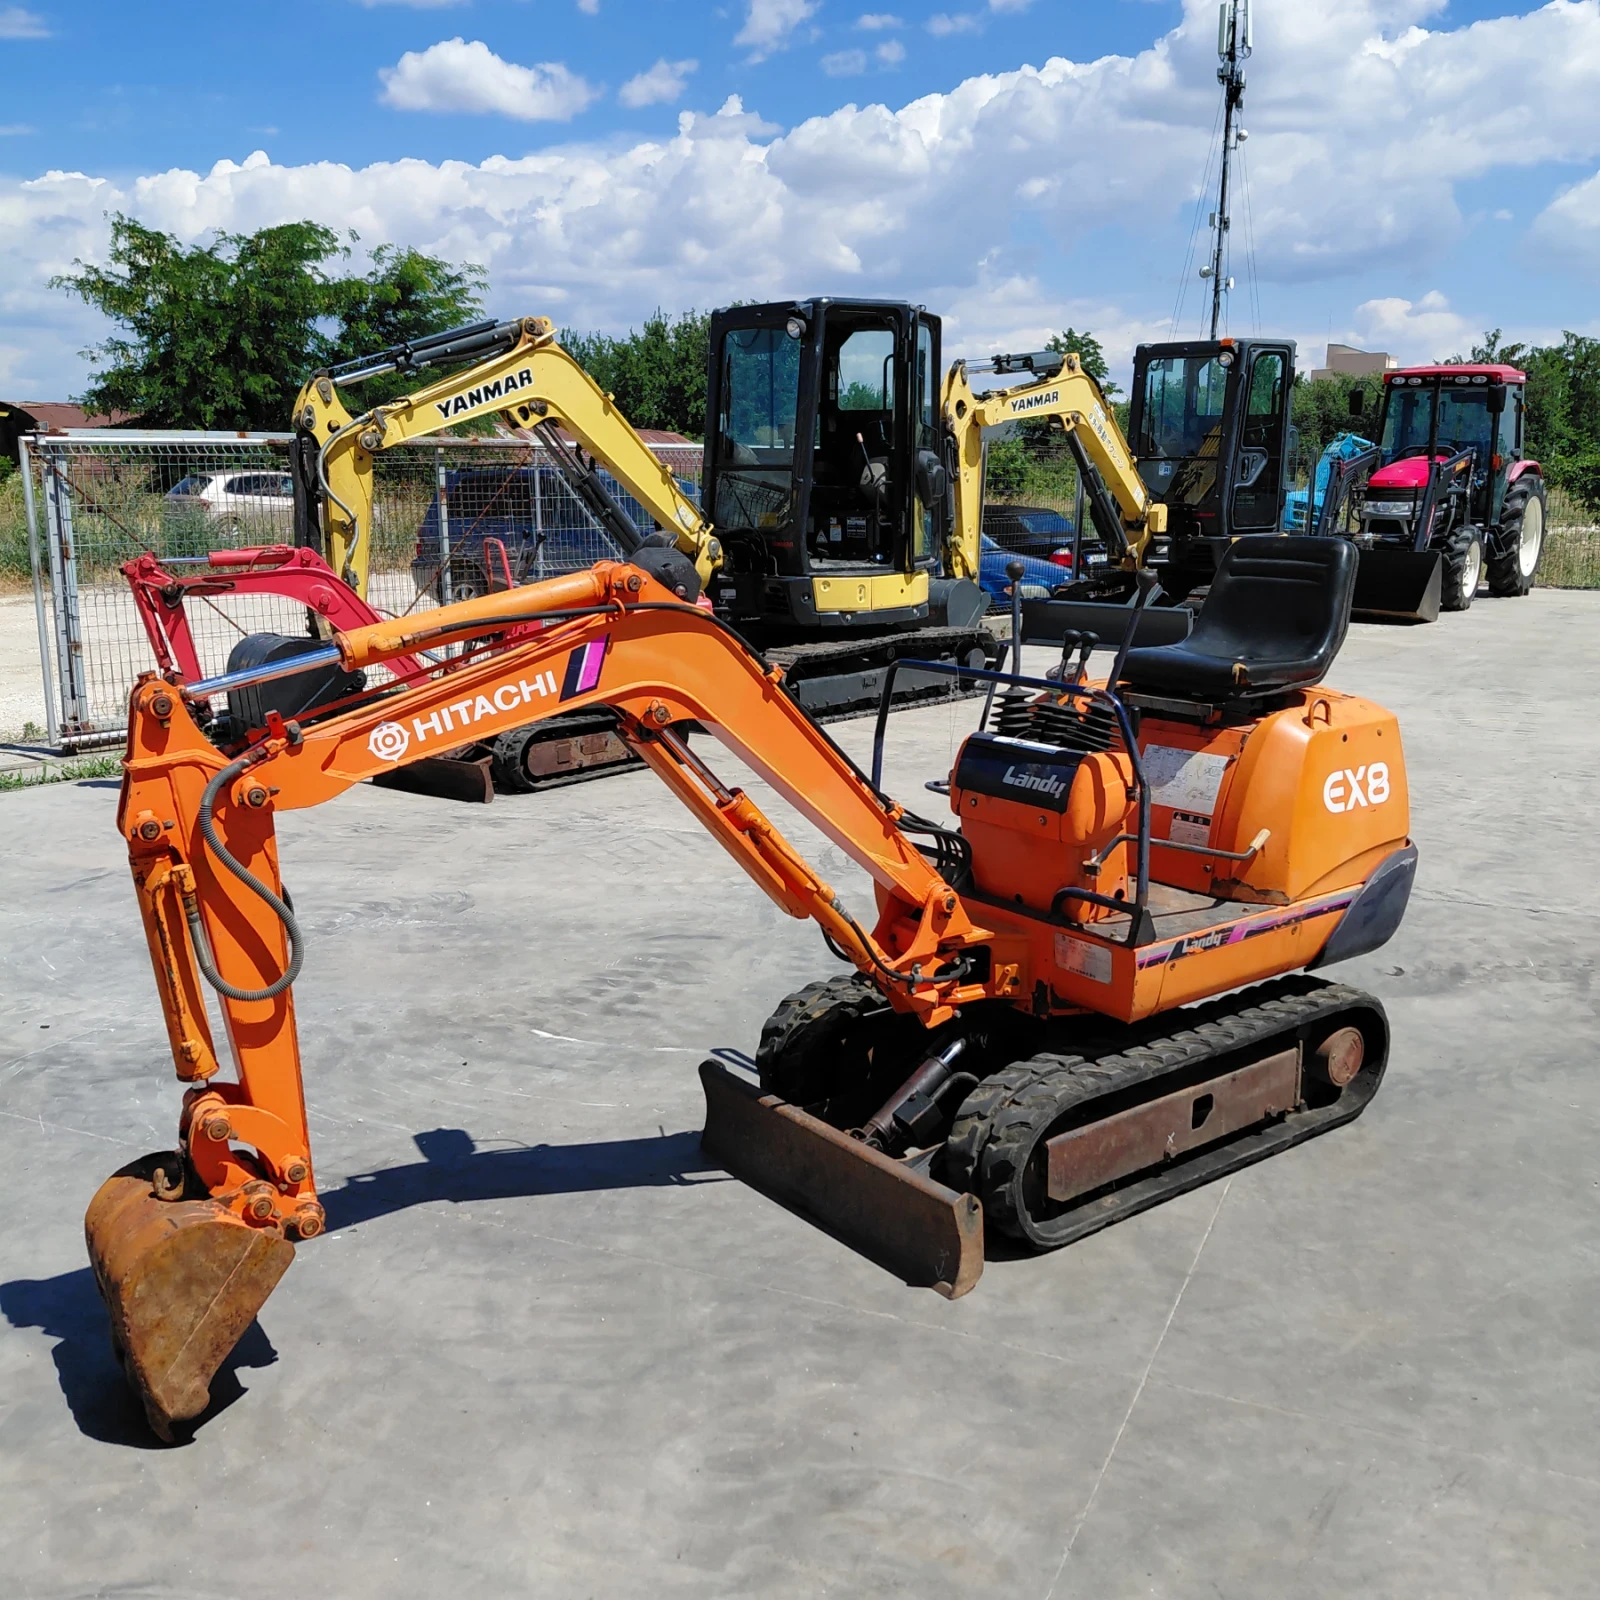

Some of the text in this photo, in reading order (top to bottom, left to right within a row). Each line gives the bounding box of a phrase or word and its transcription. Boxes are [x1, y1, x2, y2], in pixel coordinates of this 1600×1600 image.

[436, 368, 534, 419] YANMAR
[1011, 390, 1059, 412] YANMAR
[411, 670, 558, 742] HITACHI
[1002, 765, 1067, 799] Landy
[1323, 761, 1390, 814] EX8
[1182, 929, 1224, 954] Landy
